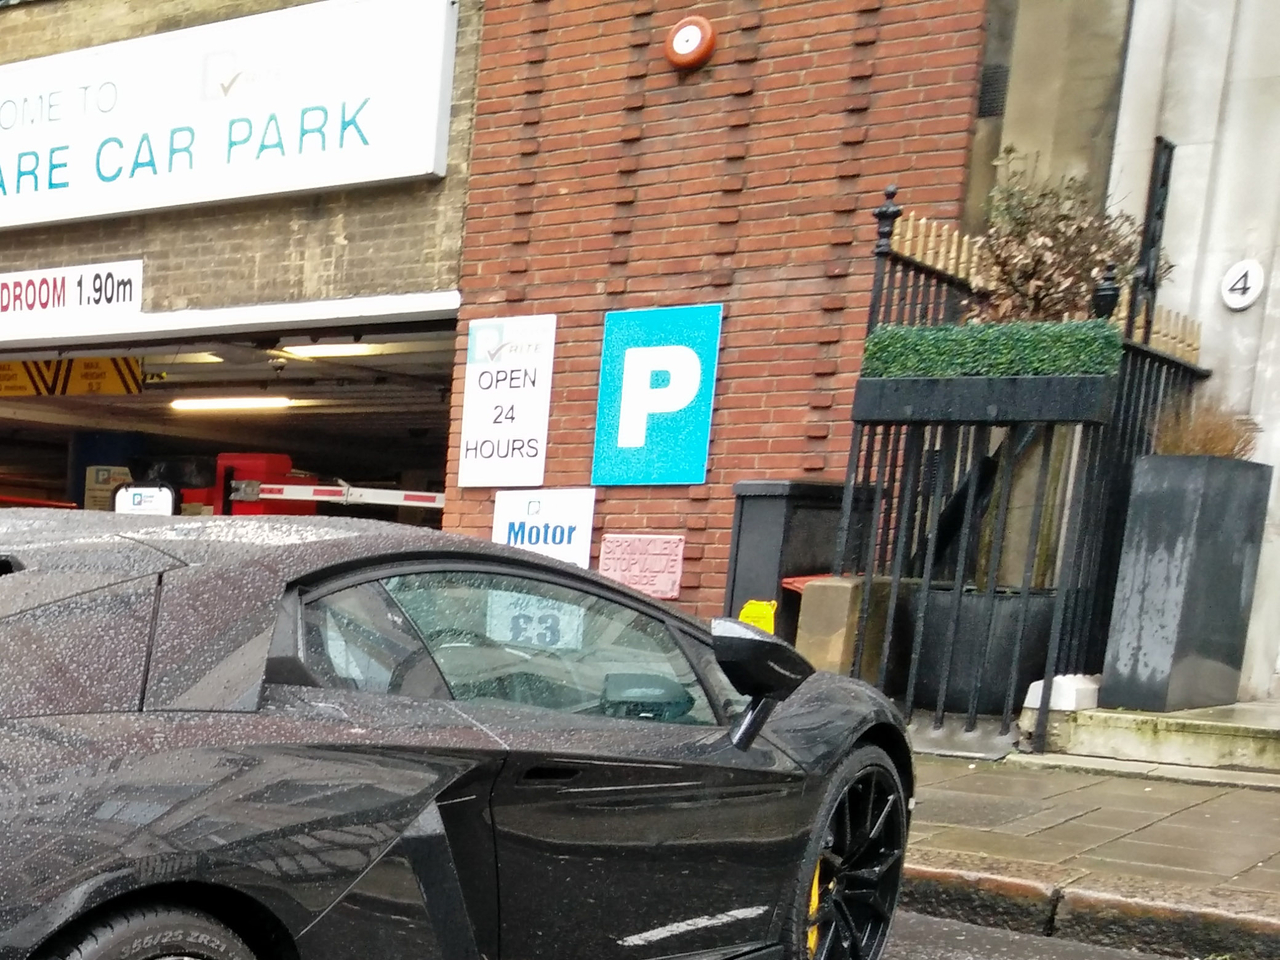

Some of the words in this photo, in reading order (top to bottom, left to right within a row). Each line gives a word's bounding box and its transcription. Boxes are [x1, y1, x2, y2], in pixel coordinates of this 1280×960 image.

[78, 81, 118, 115] TO
[95, 125, 195, 183] CAR
[226, 97, 370, 164] PARK
[76, 271, 133, 307] 1.90m
[1228, 270, 1251, 295] 4
[478, 367, 537, 390] OPEN
[617, 345, 701, 447] P
[492, 405, 515, 424] 24
[464, 438, 539, 460] HOURS
[507, 521, 576, 546] Motor
[604, 539, 680, 556] SPRINKLER
